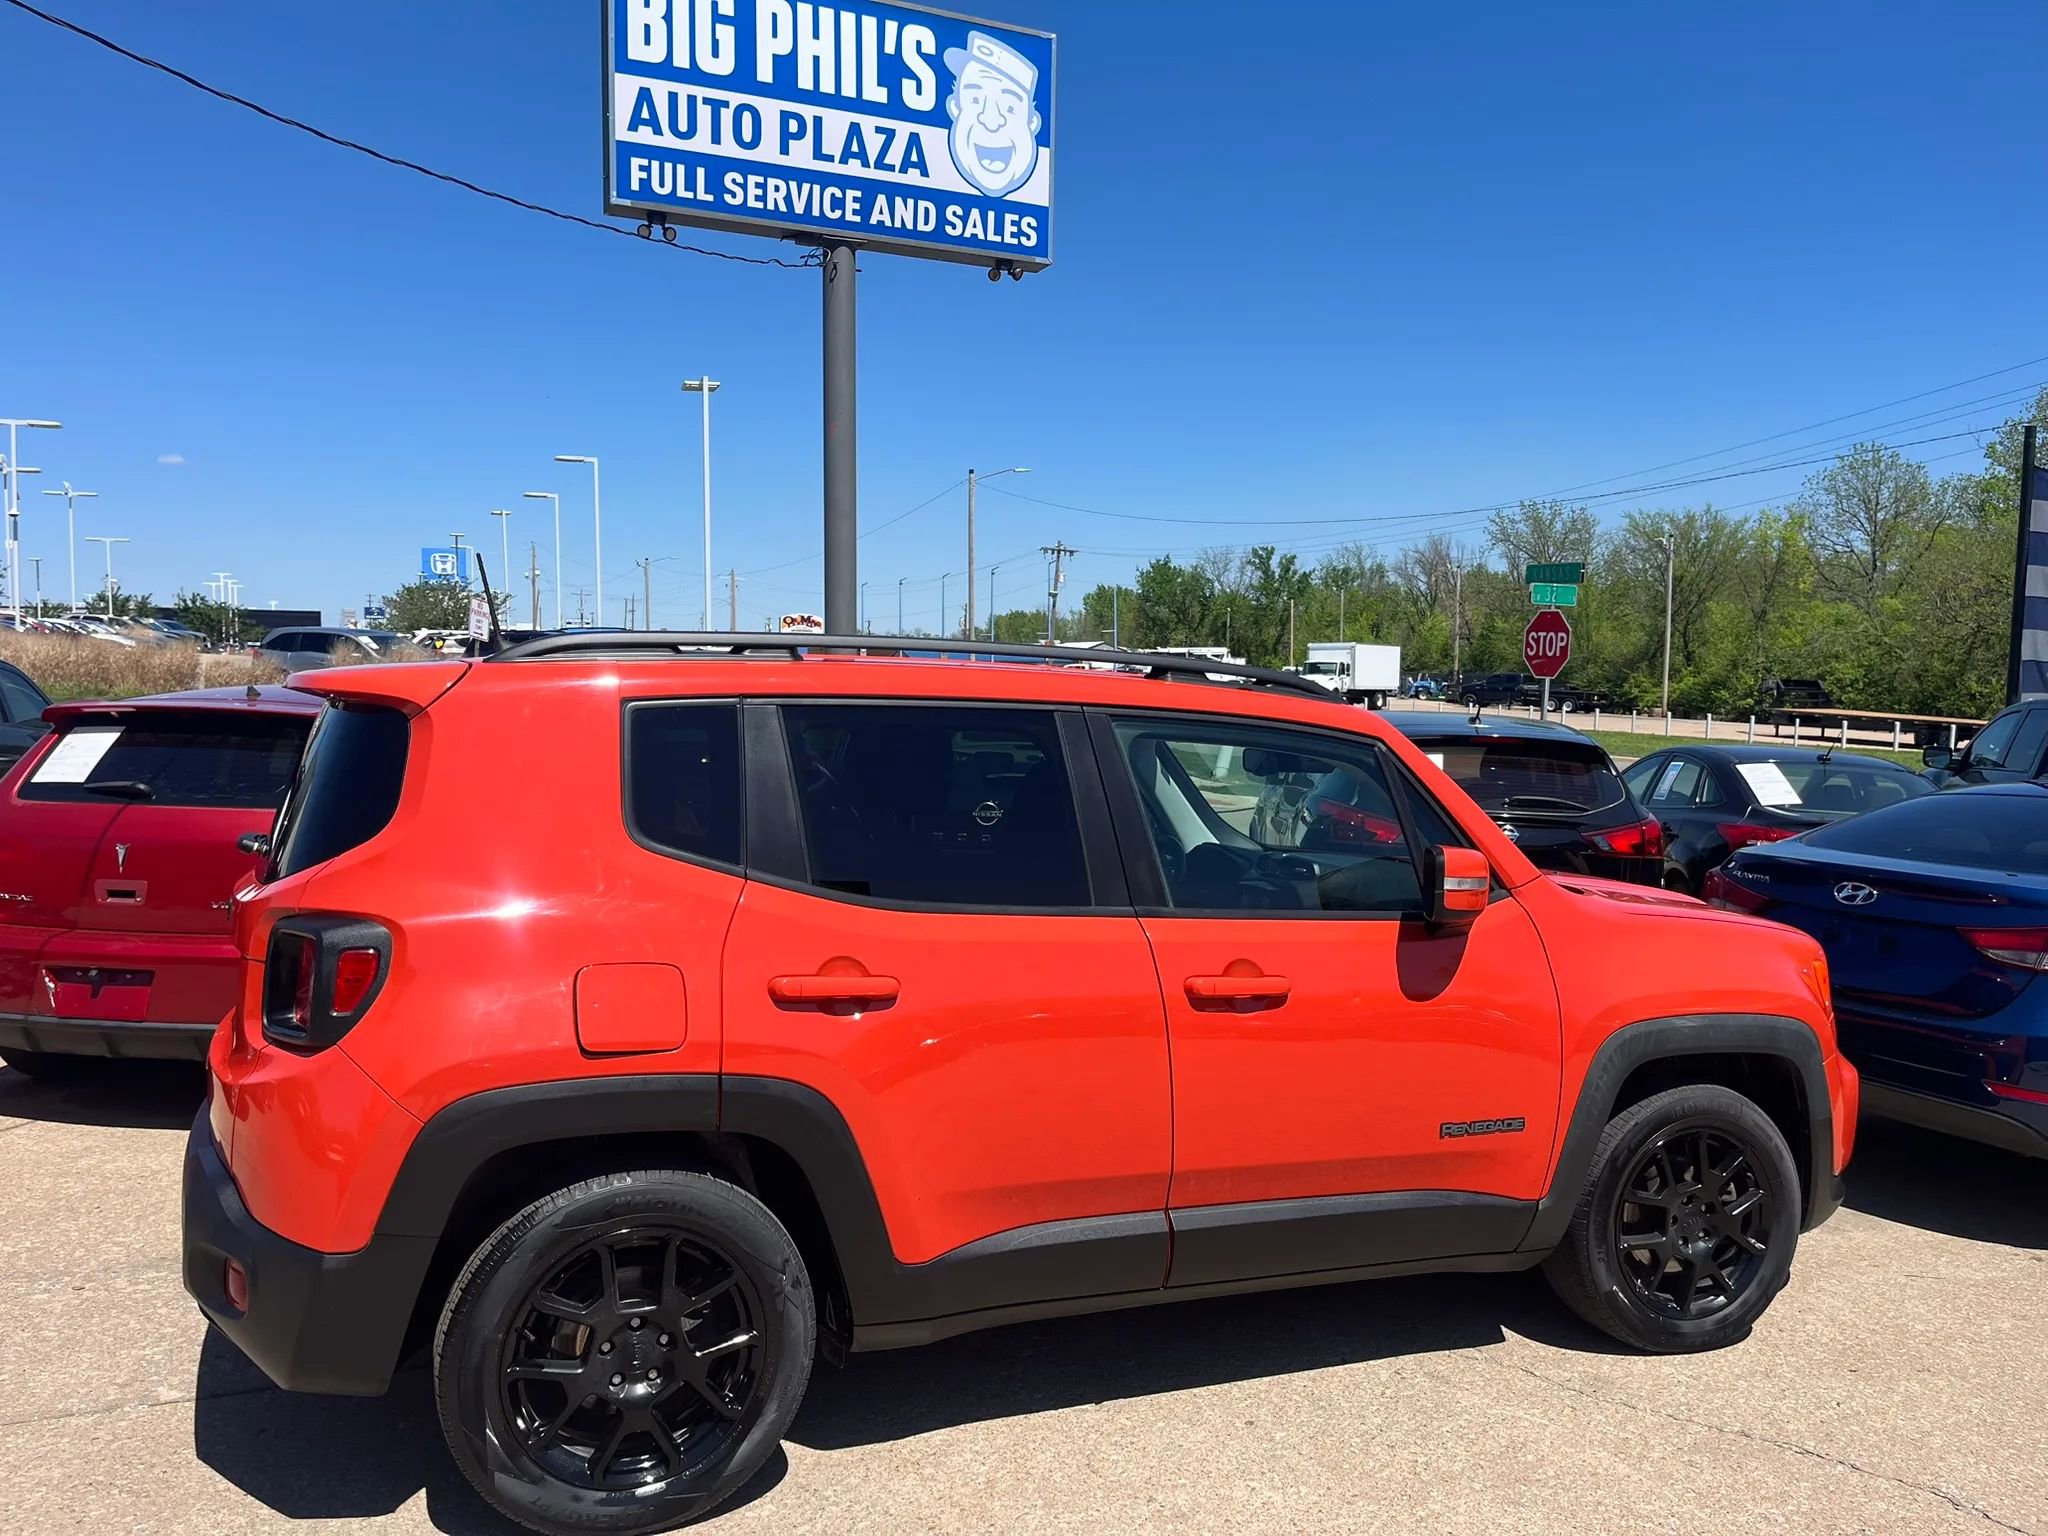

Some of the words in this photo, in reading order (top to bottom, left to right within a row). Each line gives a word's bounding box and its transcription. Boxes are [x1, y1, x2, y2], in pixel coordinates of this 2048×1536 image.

[627, 0, 736, 76] BIG
[756, 0, 937, 112] PHIL'S
[627, 87, 763, 151] AUTO
[779, 110, 930, 178] PLAZA
[630, 157, 714, 202] FULL
[723, 171, 862, 222] SERVICE
[869, 195, 936, 233] AND
[944, 206, 1038, 247] SALES
[1526, 631, 1568, 657] STOP
[1440, 1117, 1526, 1139] RENEGADE
